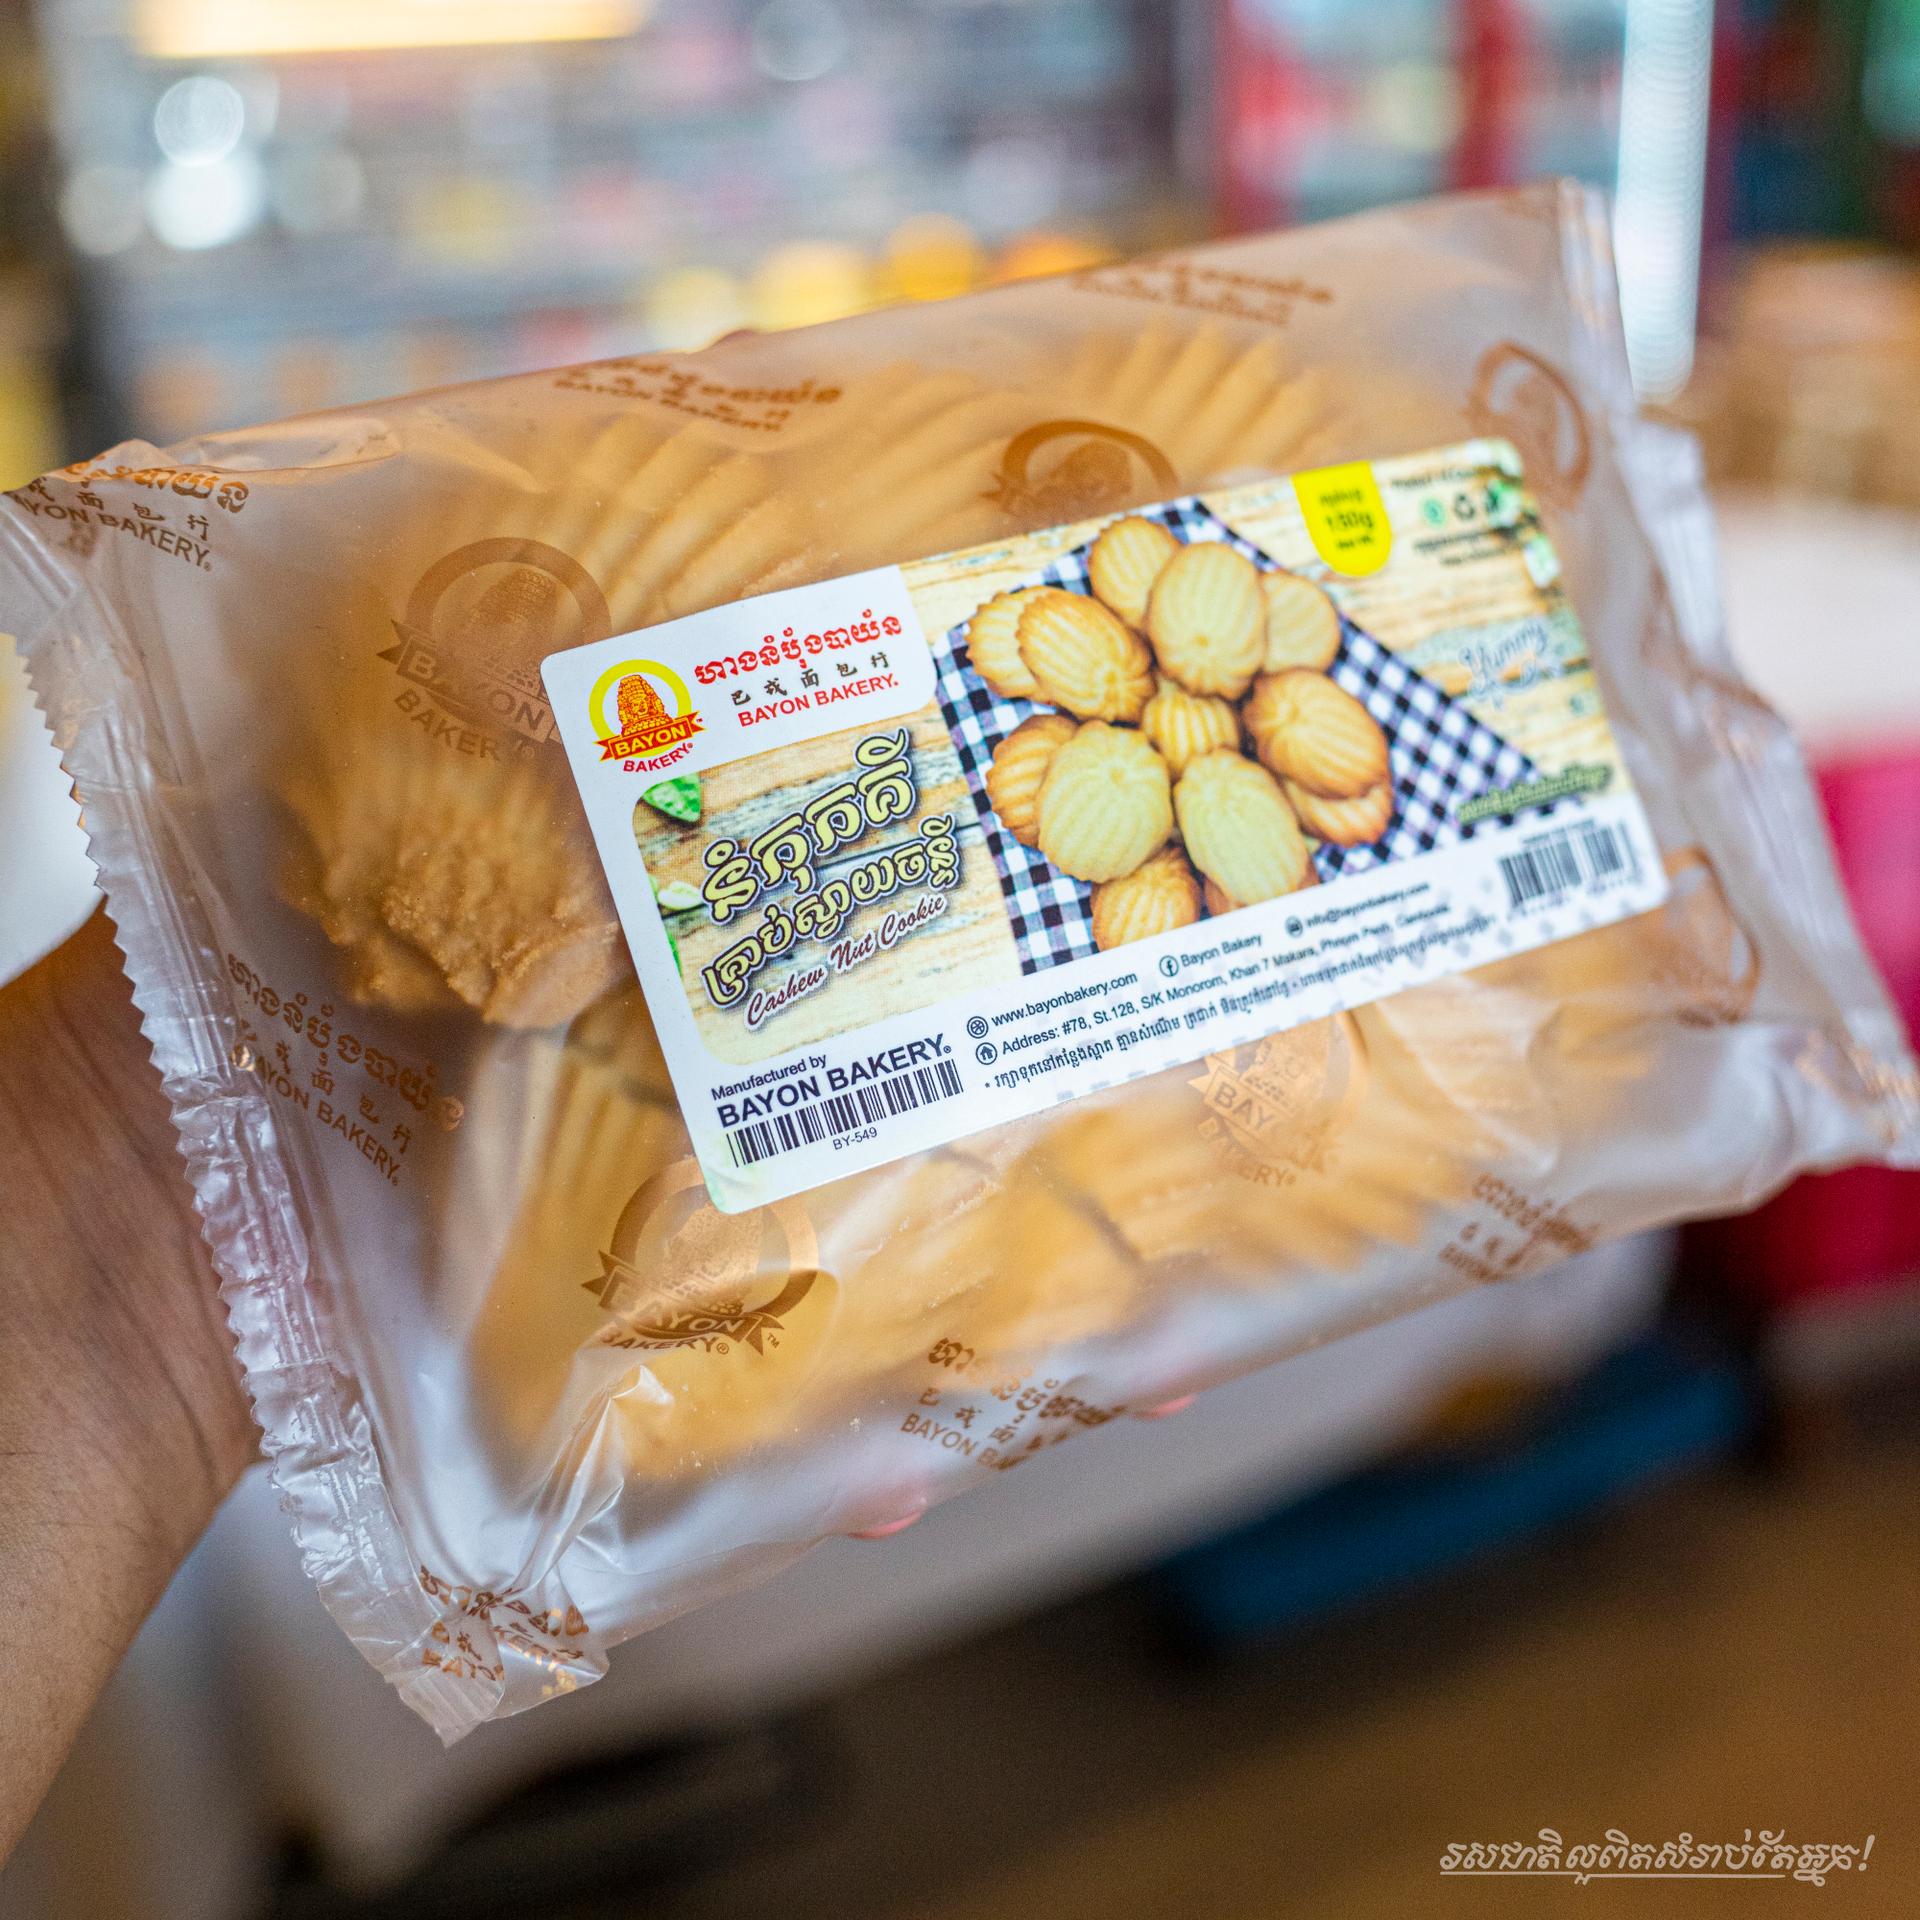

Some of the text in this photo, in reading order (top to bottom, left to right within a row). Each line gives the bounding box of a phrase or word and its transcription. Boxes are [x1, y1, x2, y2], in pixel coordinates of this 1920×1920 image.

[738, 694, 815, 727] BAYON
[615, 725, 686, 756] BAYON
[747, 895, 945, 1025] Cashew Nut Cookie
[992, 973, 1138, 1027] www.bayonbakery.com
[1181, 946, 1220, 968] Bayon
[1002, 1026, 1060, 1056] Address:
[1062, 1018, 1092, 1036] #78,
[1140, 991, 1164, 1010] S/K
[1167, 975, 1228, 1002] Monorom,
[711, 1055, 827, 1101] Manufactured by
[717, 1076, 821, 1128] BAYON
[832, 1126, 878, 1151] BY-549
